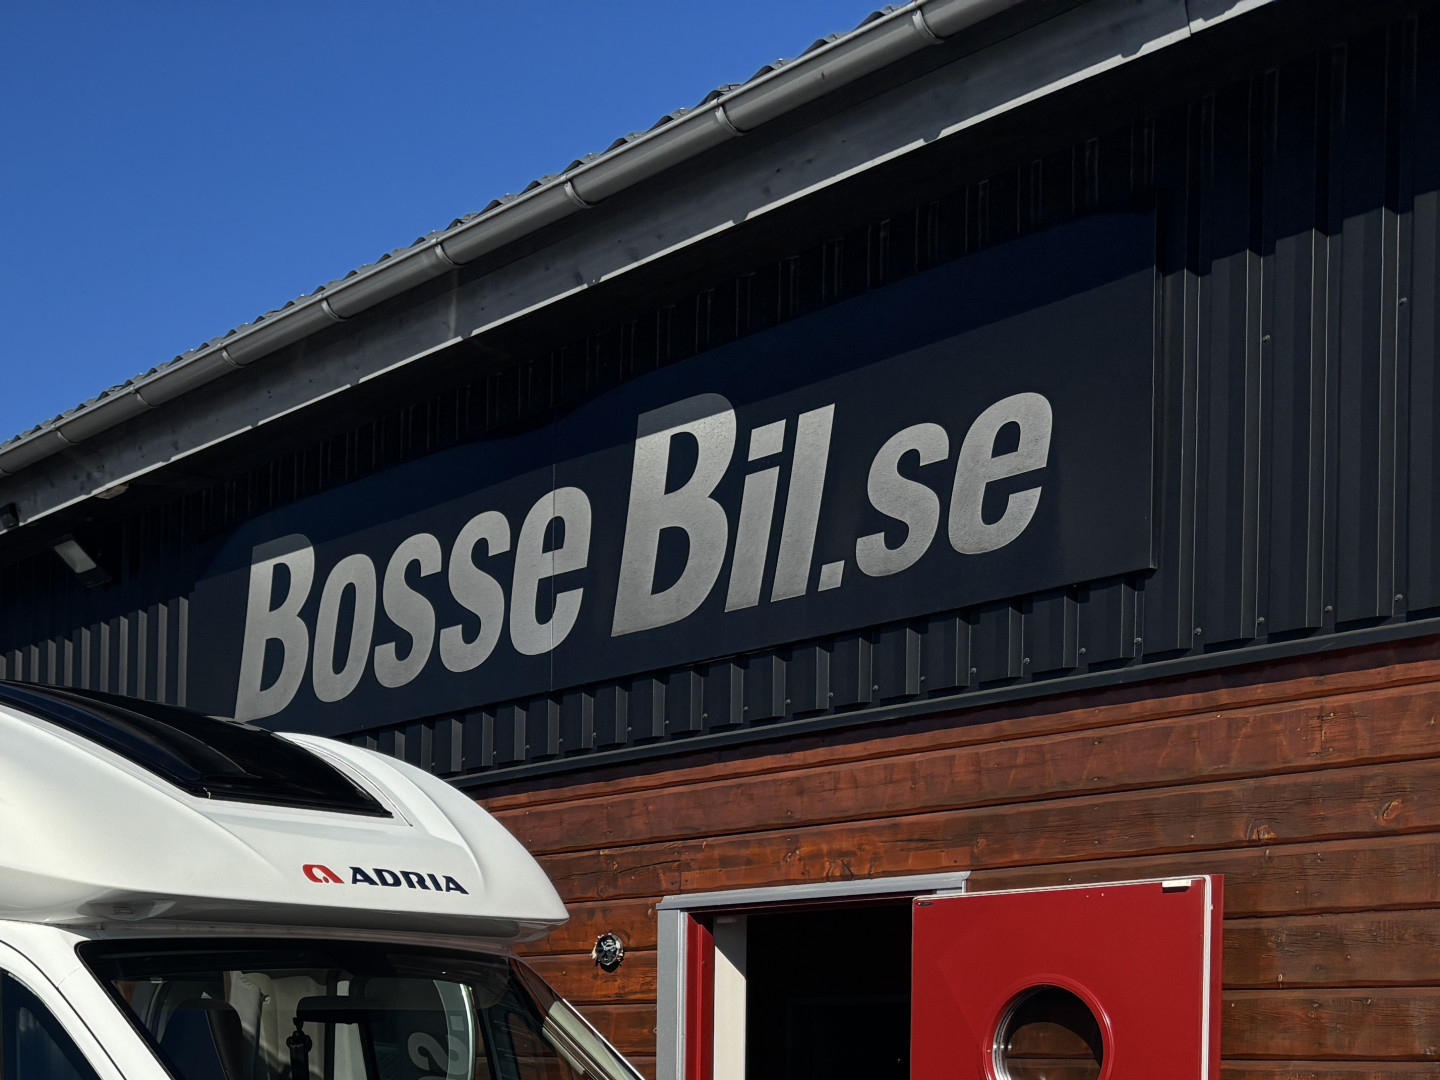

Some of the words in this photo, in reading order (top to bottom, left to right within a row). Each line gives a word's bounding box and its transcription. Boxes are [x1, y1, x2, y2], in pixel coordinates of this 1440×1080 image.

[234, 487, 592, 722] Bosse
[611, 392, 1052, 637] Bil.se
[349, 866, 470, 895] ADRIA
